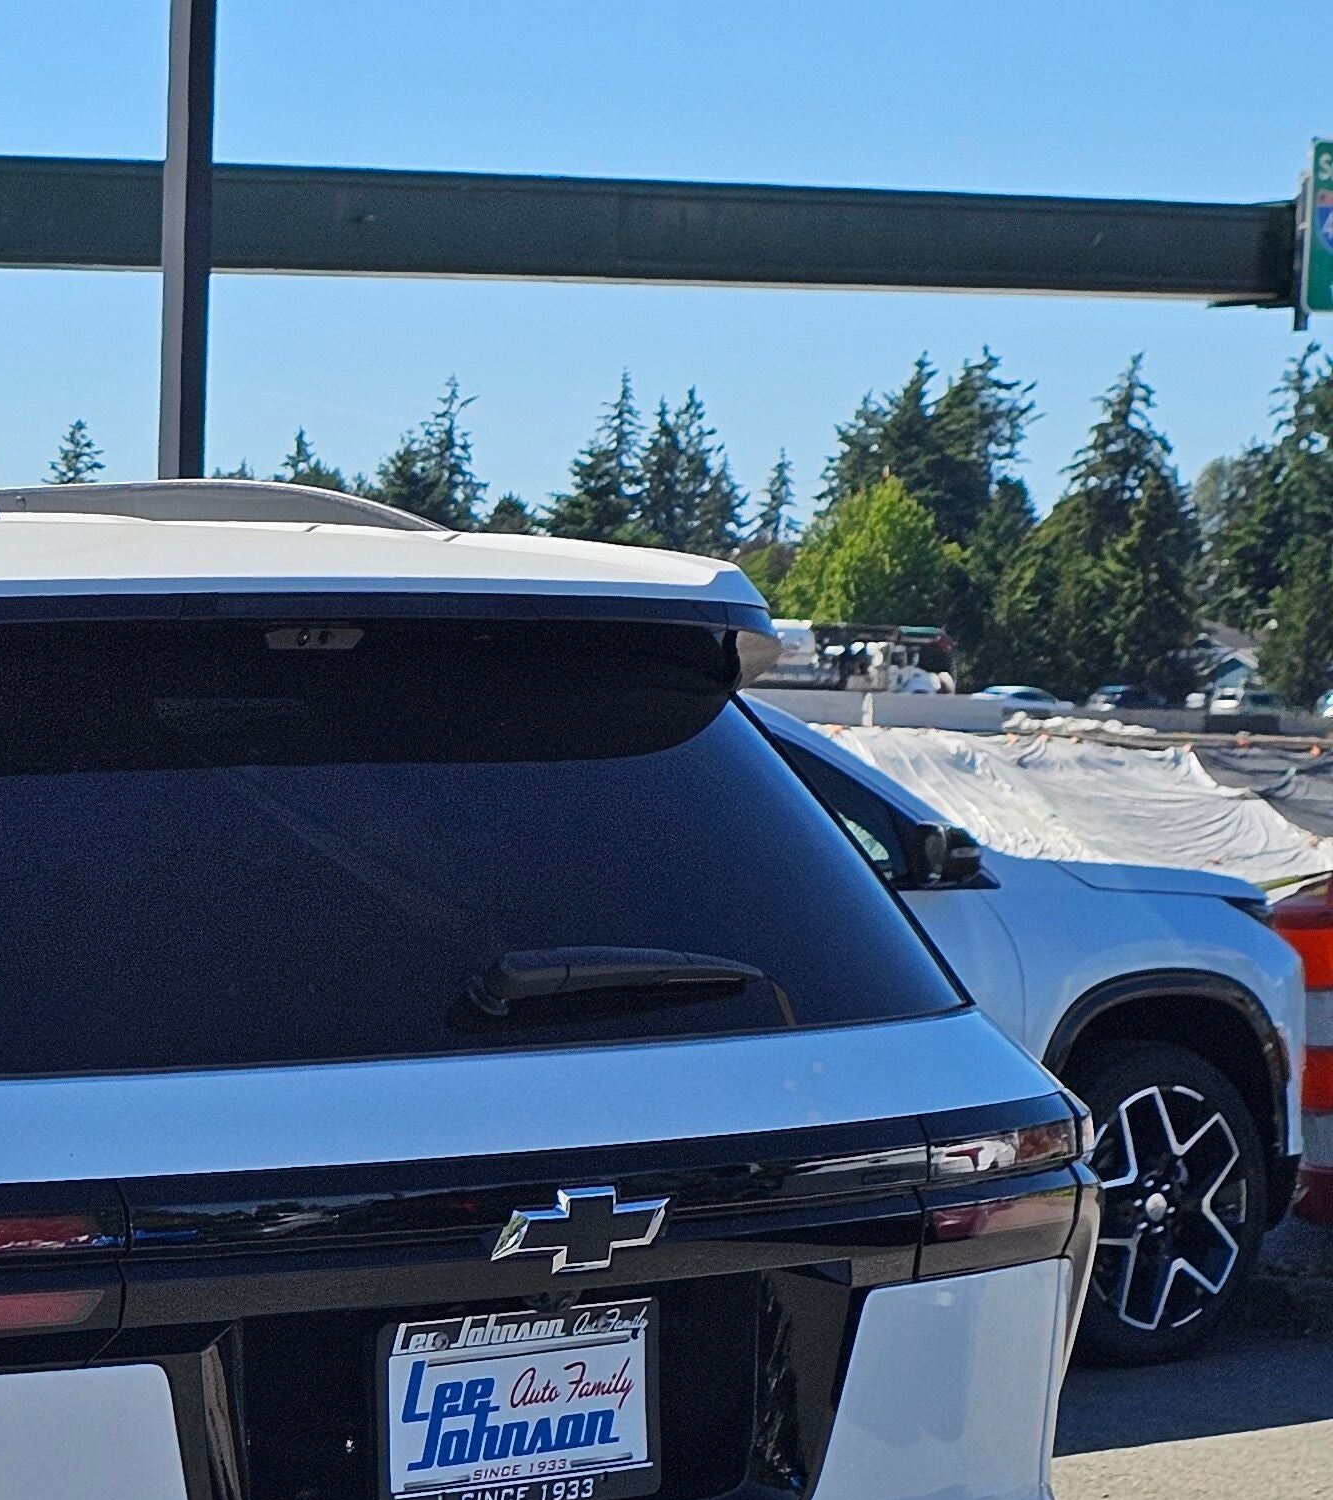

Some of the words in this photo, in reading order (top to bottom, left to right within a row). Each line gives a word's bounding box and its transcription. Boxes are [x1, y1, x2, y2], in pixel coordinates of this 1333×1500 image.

[450, 1314, 567, 1350] Johnson
[573, 1311, 607, 1335] Aut
[402, 1360, 496, 1423] Lee
[510, 1367, 559, 1408] Auto
[564, 1357, 635, 1409] Family
[407, 1403, 620, 1472] Johnson
[473, 1464, 521, 1480] SINCE
[529, 1458, 568, 1473] 1933
